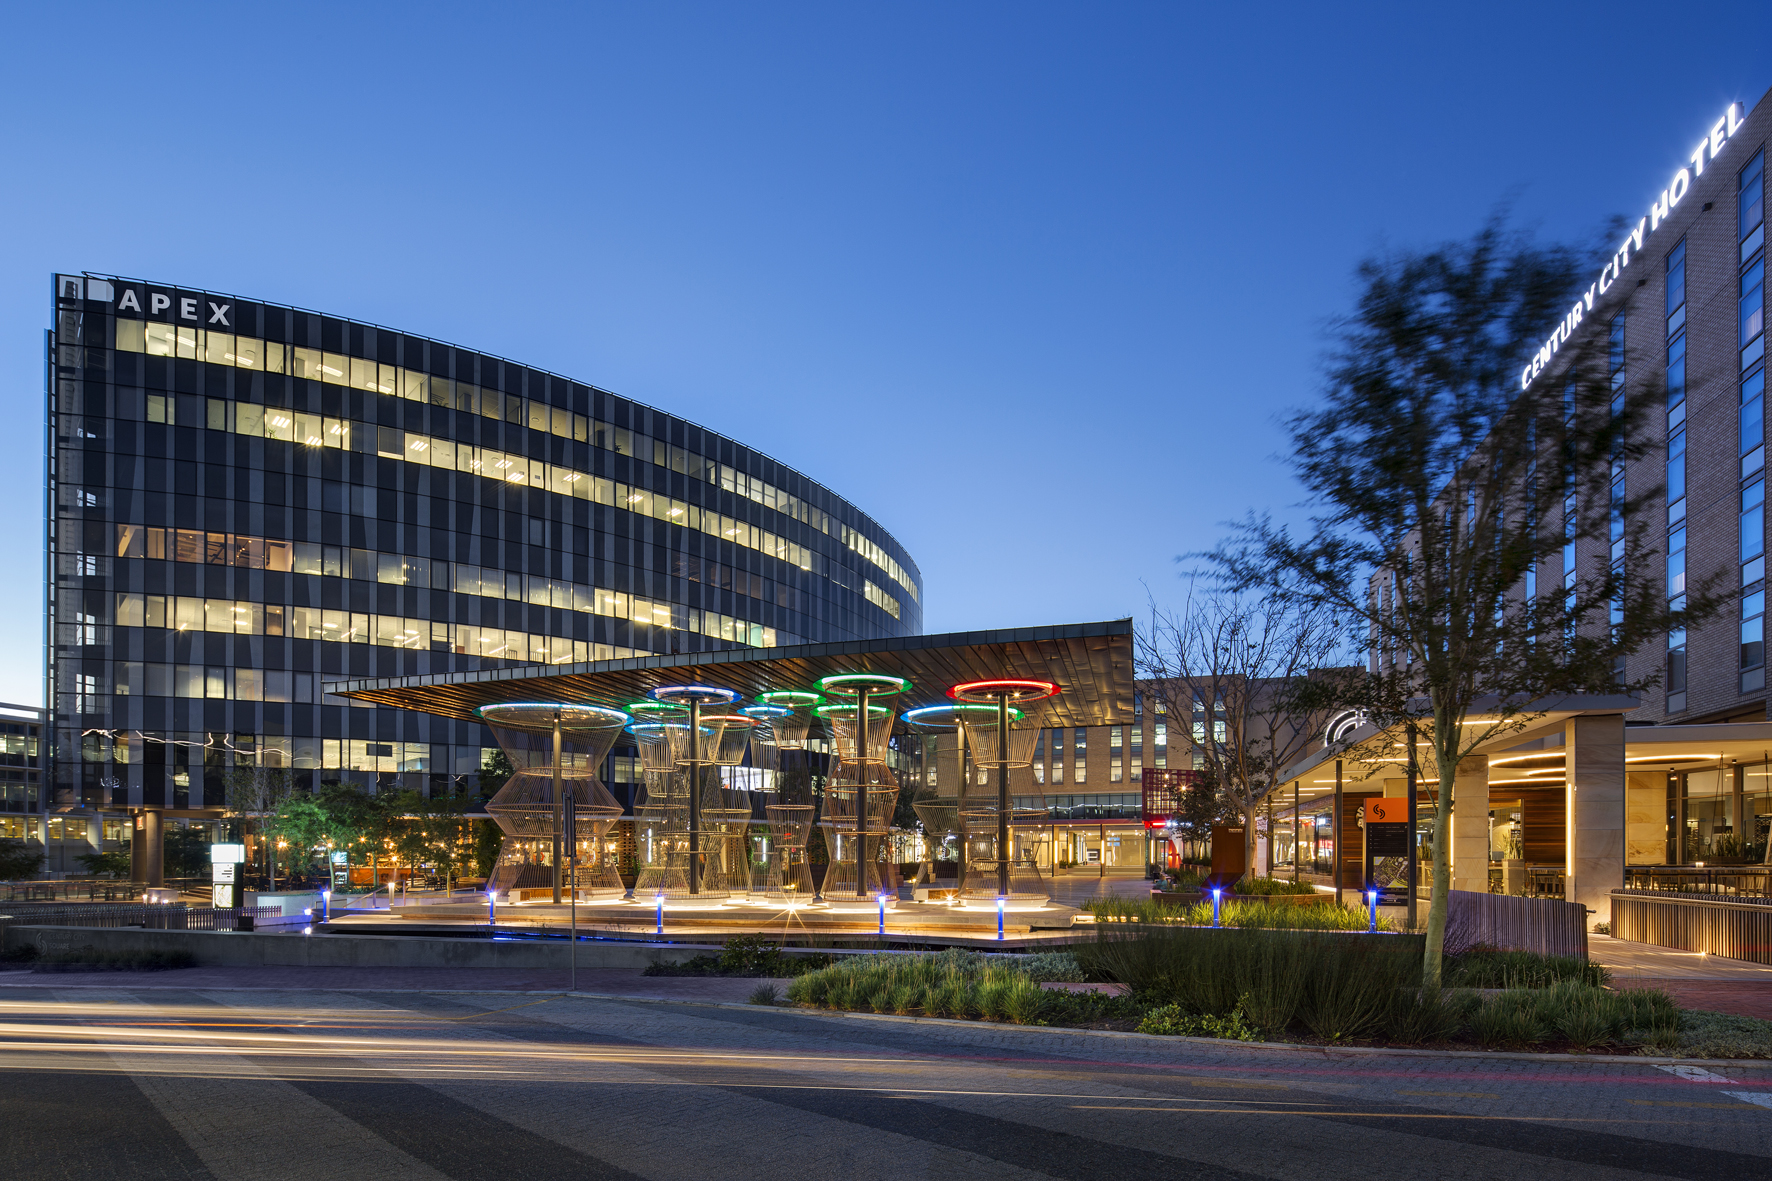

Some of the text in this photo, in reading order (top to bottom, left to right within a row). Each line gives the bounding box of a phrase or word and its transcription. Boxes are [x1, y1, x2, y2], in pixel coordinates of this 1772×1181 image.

[118, 289, 231, 326] APEX
[1522, 102, 1744, 390] CENTURY CITY HOTEL
